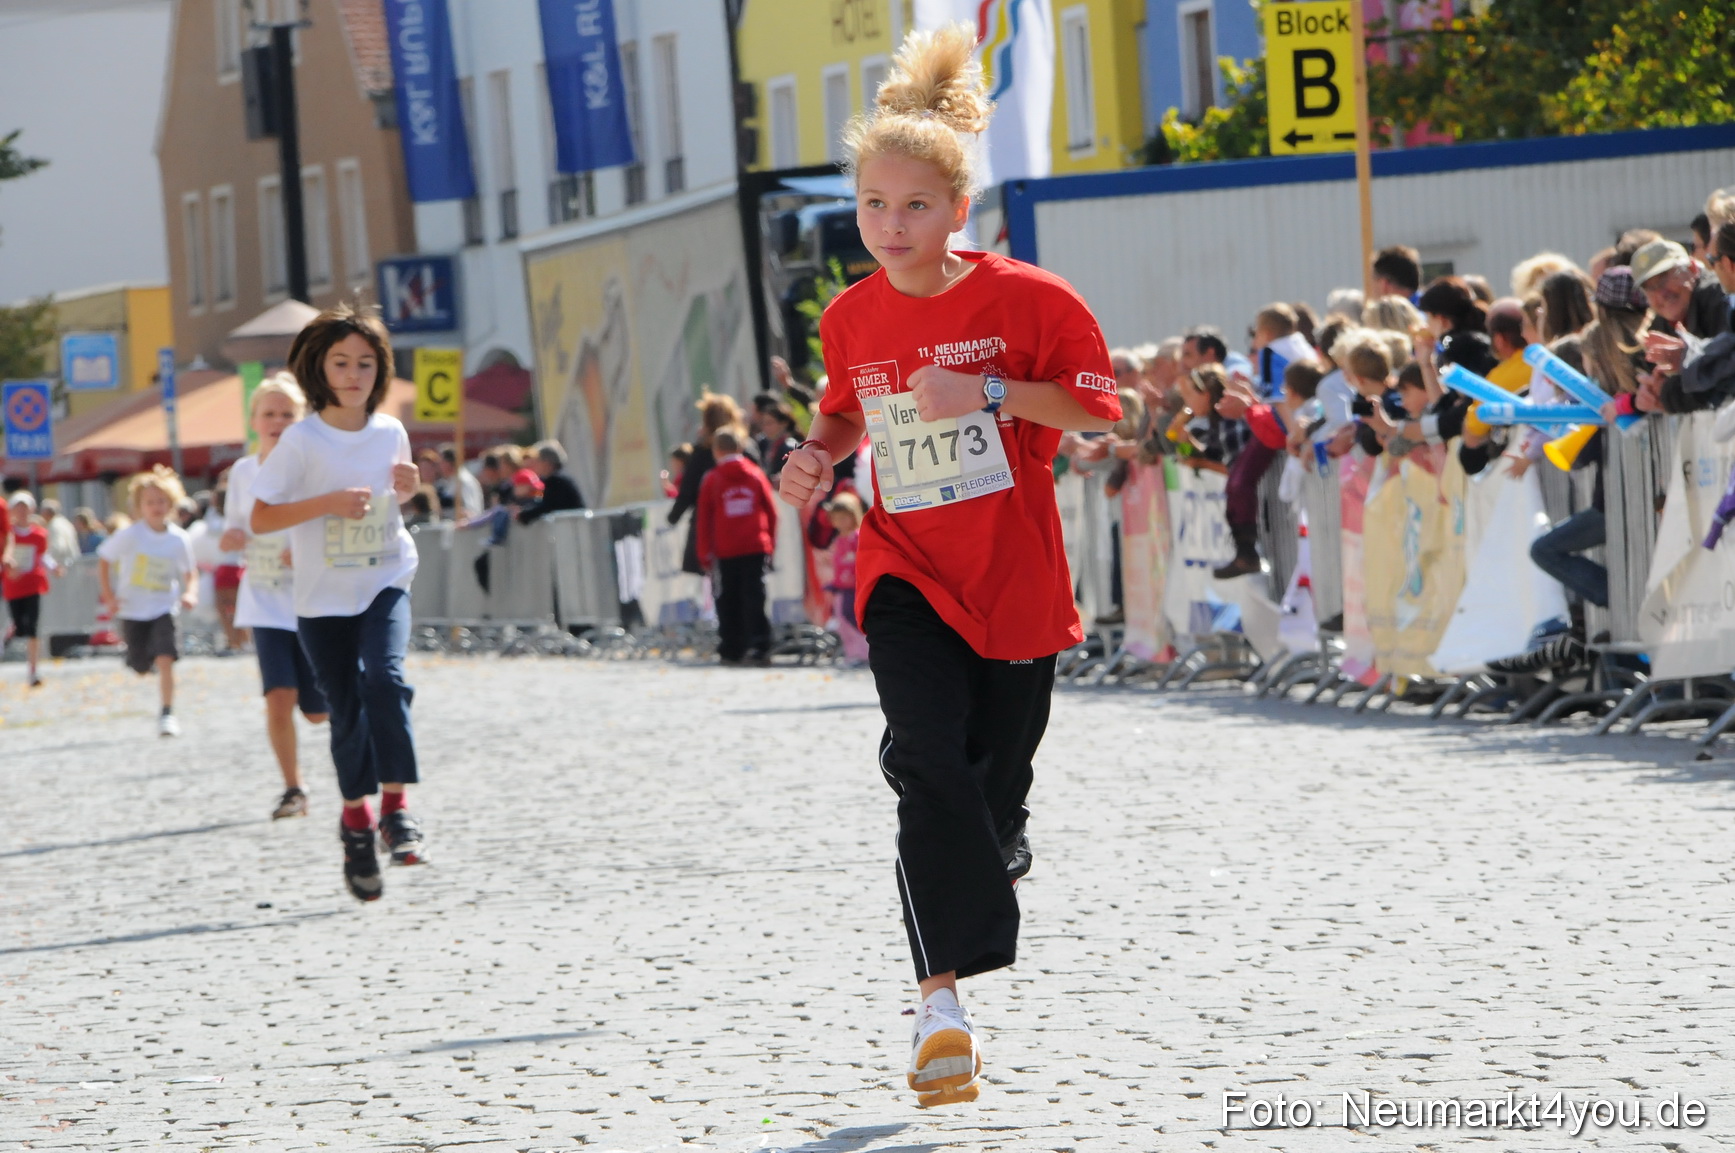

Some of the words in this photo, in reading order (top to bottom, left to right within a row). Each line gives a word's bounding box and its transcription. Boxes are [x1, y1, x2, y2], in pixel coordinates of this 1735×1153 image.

[1277, 8, 1351, 36] Block
[1293, 48, 1340, 118] B
[918, 347, 933, 358] 11.
[935, 336, 1006, 356] NEUMARKTER
[933, 347, 998, 367] STADTLAUF
[428, 371, 452, 405] C
[852, 373, 889, 388] IMMER
[1076, 372, 1117, 395] BOCK
[888, 403, 920, 426] Ver
[899, 425, 988, 471] 7173
[955, 471, 1009, 493] PFLEIDERER
